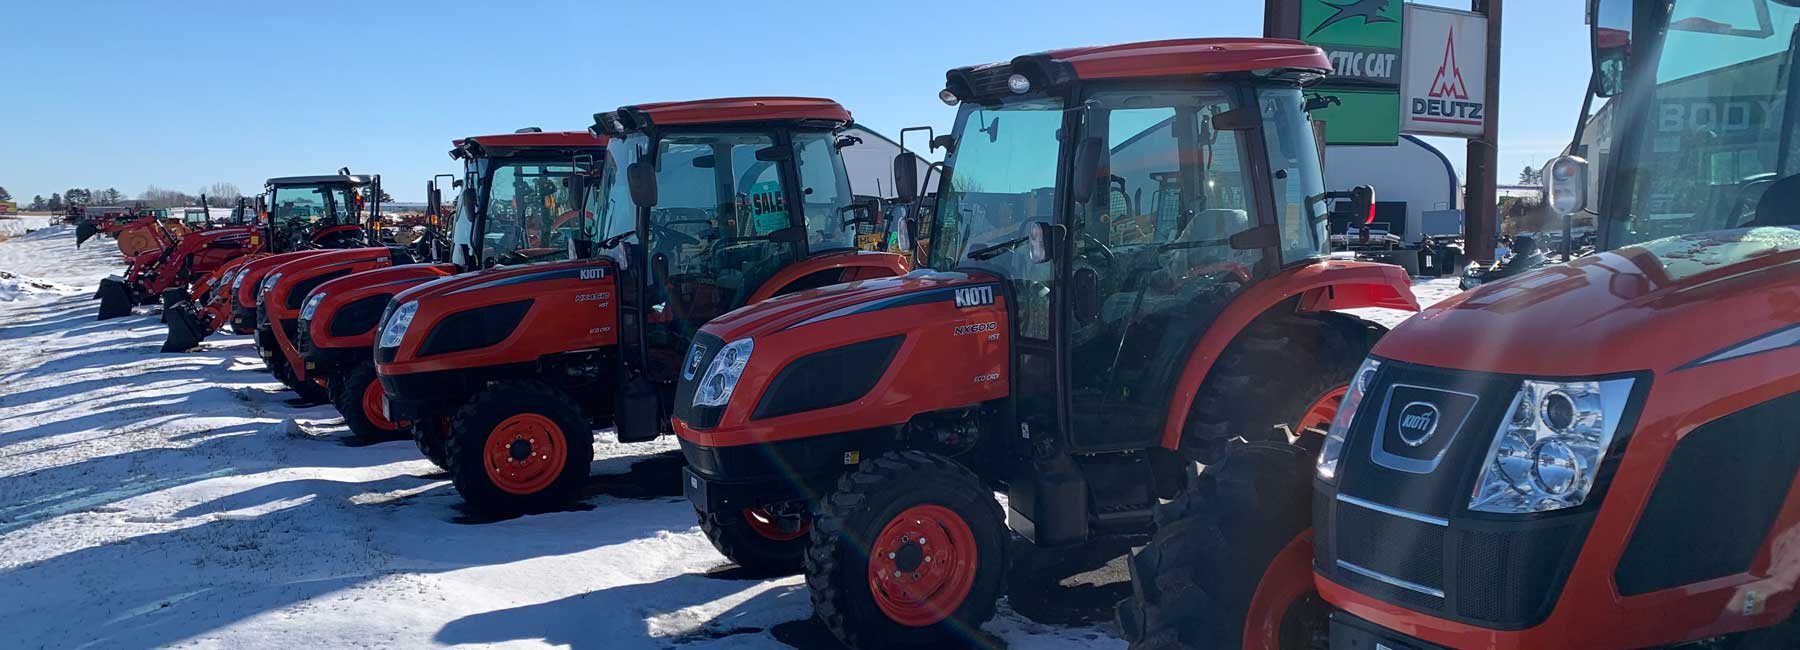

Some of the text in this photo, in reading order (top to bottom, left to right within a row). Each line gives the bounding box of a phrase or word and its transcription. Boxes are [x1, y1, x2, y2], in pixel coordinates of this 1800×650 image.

[1328, 51, 1396, 78] CTIC CAT
[1412, 98, 1482, 119] DEUTZ
[1659, 100, 1778, 132] BODY
[753, 191, 783, 215] SALE
[580, 268, 604, 280] KIOTI
[955, 286, 993, 307] KIOTI
[954, 322, 997, 335] NX6010
[1402, 413, 1431, 430] KIOTI
